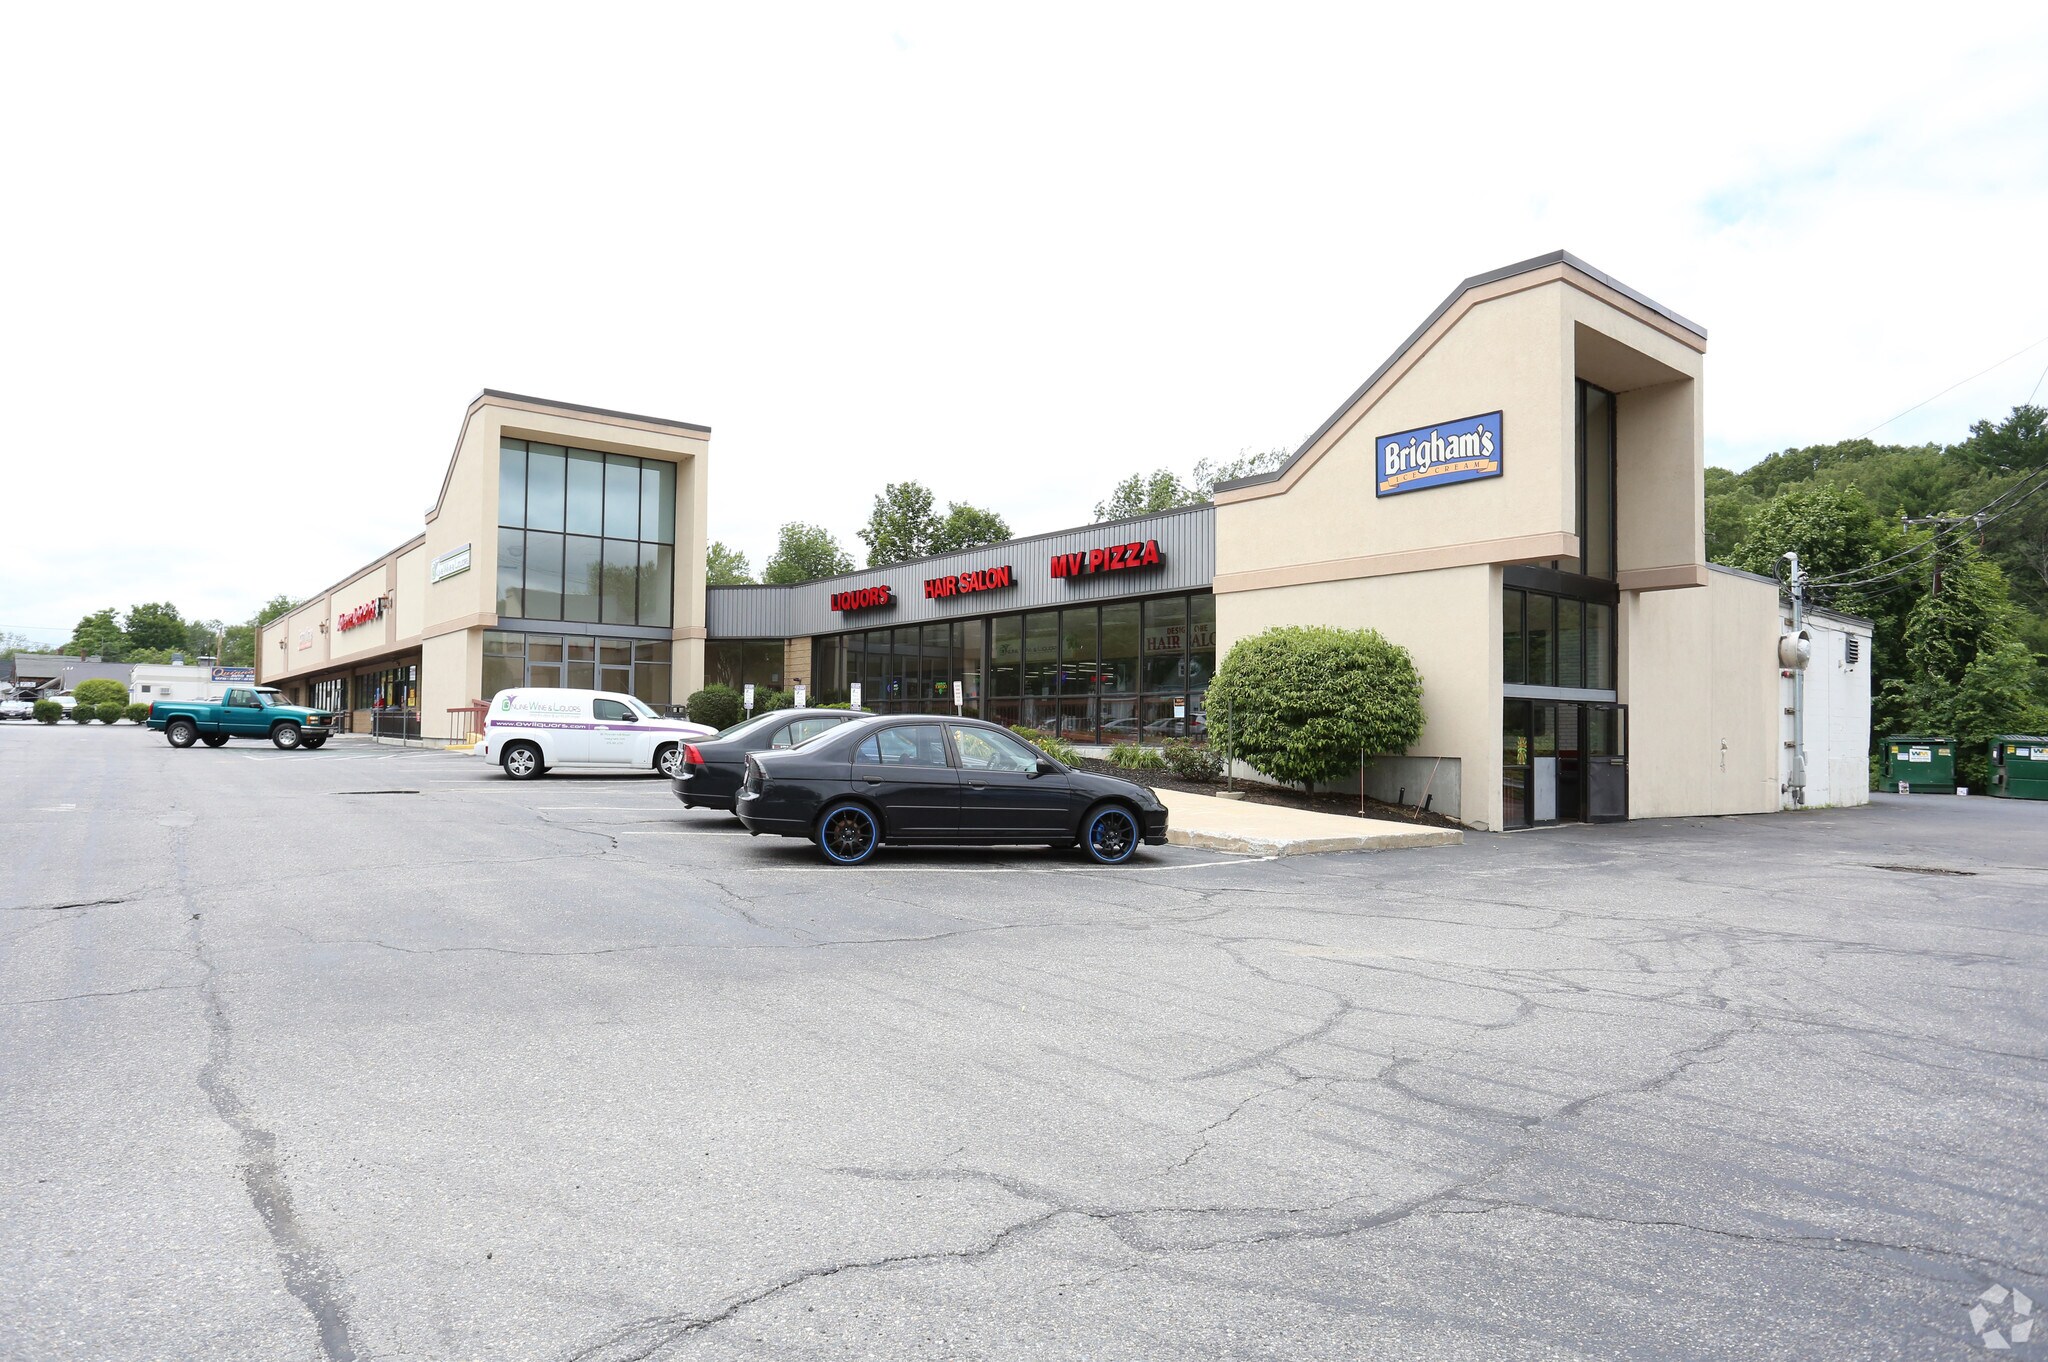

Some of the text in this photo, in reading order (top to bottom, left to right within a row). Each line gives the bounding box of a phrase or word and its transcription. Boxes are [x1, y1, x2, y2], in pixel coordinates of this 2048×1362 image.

[1384, 424, 1495, 475] Brigham's
[1396, 461, 1481, 483] ICE CREAM
[1051, 540, 1160, 578] MV PIZZA
[924, 565, 1010, 599] HAIR SALON
[831, 585, 889, 611] LIQUORS
[1147, 635, 1181, 650] HAIR
[1167, 626, 1186, 635] DESIG
[529, 701, 547, 711] WINE
[553, 701, 581, 712] LIQUORS
